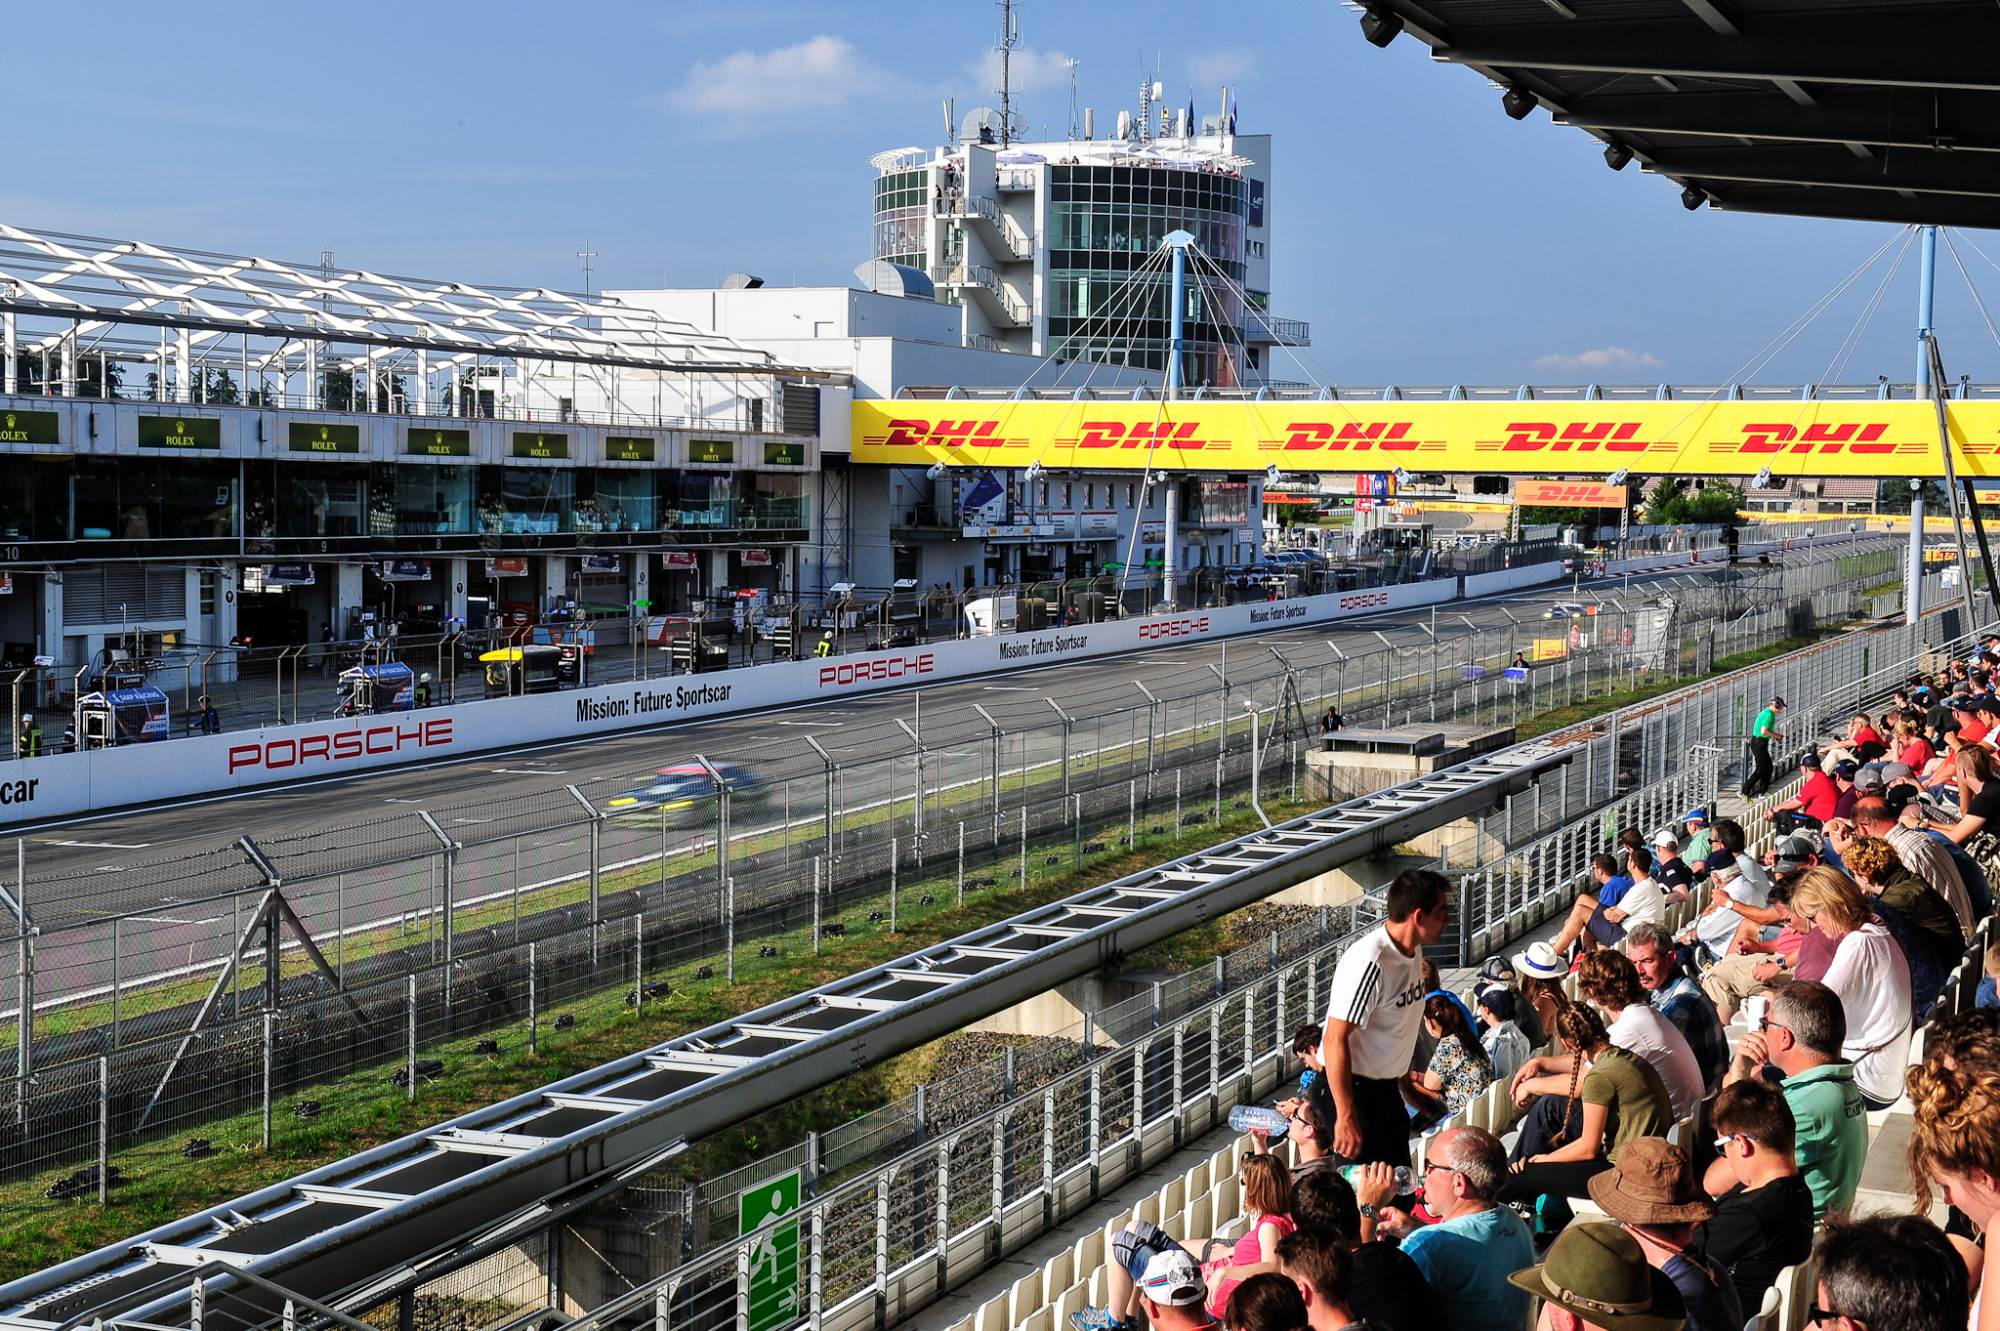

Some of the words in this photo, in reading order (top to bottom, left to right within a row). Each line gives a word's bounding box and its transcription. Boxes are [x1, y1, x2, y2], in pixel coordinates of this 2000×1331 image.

[0, 430, 28, 441] OLEX
[165, 435, 196, 447] ROLEX
[885, 419, 1006, 448] DHL
[1078, 421, 1207, 450] DHL
[1283, 422, 1421, 451] DHL
[1502, 422, 1651, 452] DHL
[1738, 423, 1898, 454] DHL
[311, 440, 338, 451] ROLEX
[427, 445, 451, 455] ROLEX
[530, 447, 551, 457] ROLEX
[621, 451, 640, 460] ROLEX
[702, 454, 720, 462] ROLEX
[776, 456, 792, 464] ROLEX
[1537, 485, 1606, 503] DHL
[321, 540, 328, 553] 9
[537, 536, 542, 547] 7
[627, 534, 632, 544] 6
[5, 546, 19, 560] 10
[1340, 592, 1388, 610] PORSCHE
[1249, 608, 1269, 624] Mission:
[1270, 606, 1285, 621] Future
[1285, 604, 1307, 620] Sportscar
[1139, 617, 1209, 641] PORSCHE
[999, 641, 1029, 660] Mission:
[1031, 638, 1054, 655] Future
[1055, 634, 1088, 655] Sportscar
[819, 653, 934, 688] PORSCHE
[576, 696, 629, 722] Mission:
[633, 691, 673, 714] Future
[676, 683, 732, 711] Sportscar
[228, 718, 454, 775] PORSCHE
